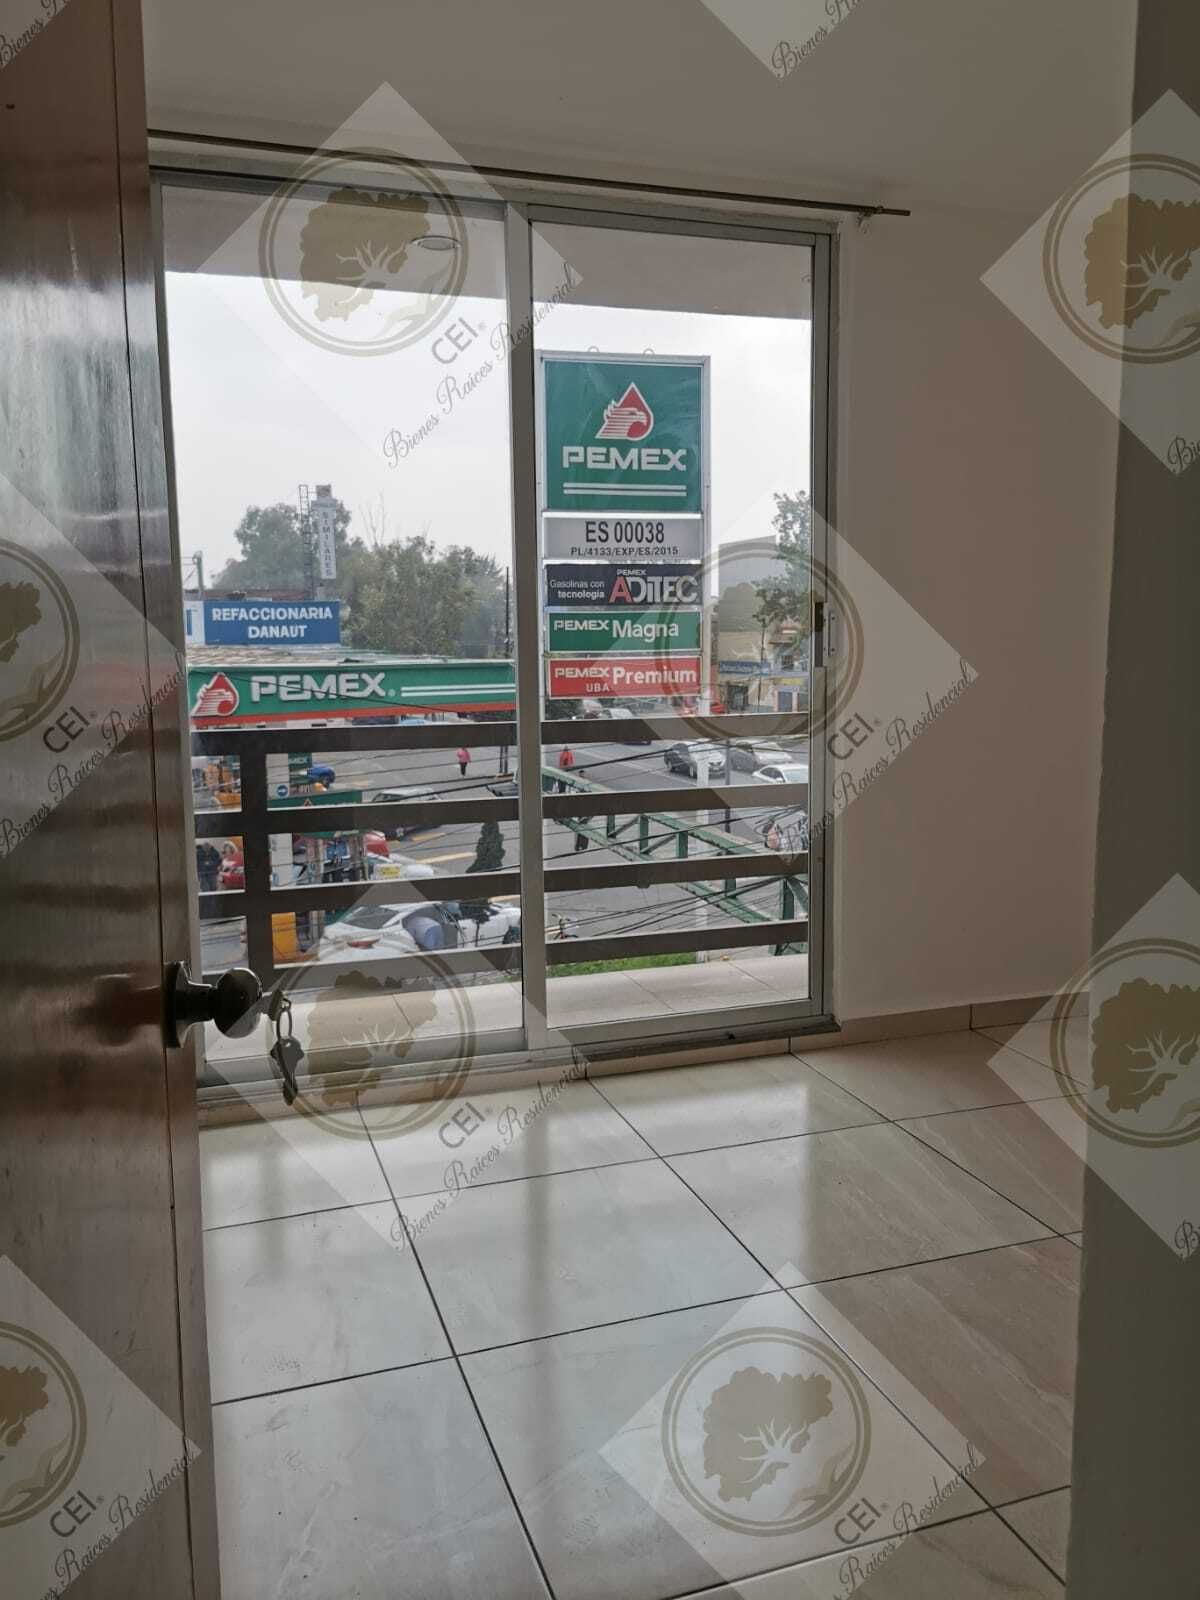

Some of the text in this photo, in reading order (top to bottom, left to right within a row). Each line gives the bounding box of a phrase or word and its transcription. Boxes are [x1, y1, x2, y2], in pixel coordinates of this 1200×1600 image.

[562, 446, 687, 471] PEMEX
[586, 521, 665, 543] ES 00038
[571, 546, 679, 557] PL/4133/EXP/ES/2015
[617, 568, 647, 576] PEMEX
[550, 579, 605, 588] Gasolinas con
[212, 607, 333, 621] REFACCIONARIA
[248, 625, 307, 638] DANAUT
[554, 619, 679, 642] PEMEX Magna
[554, 666, 697, 684] PEMEX Premium
[250, 672, 386, 703] PEMEX
[586, 682, 611, 692] UBA
